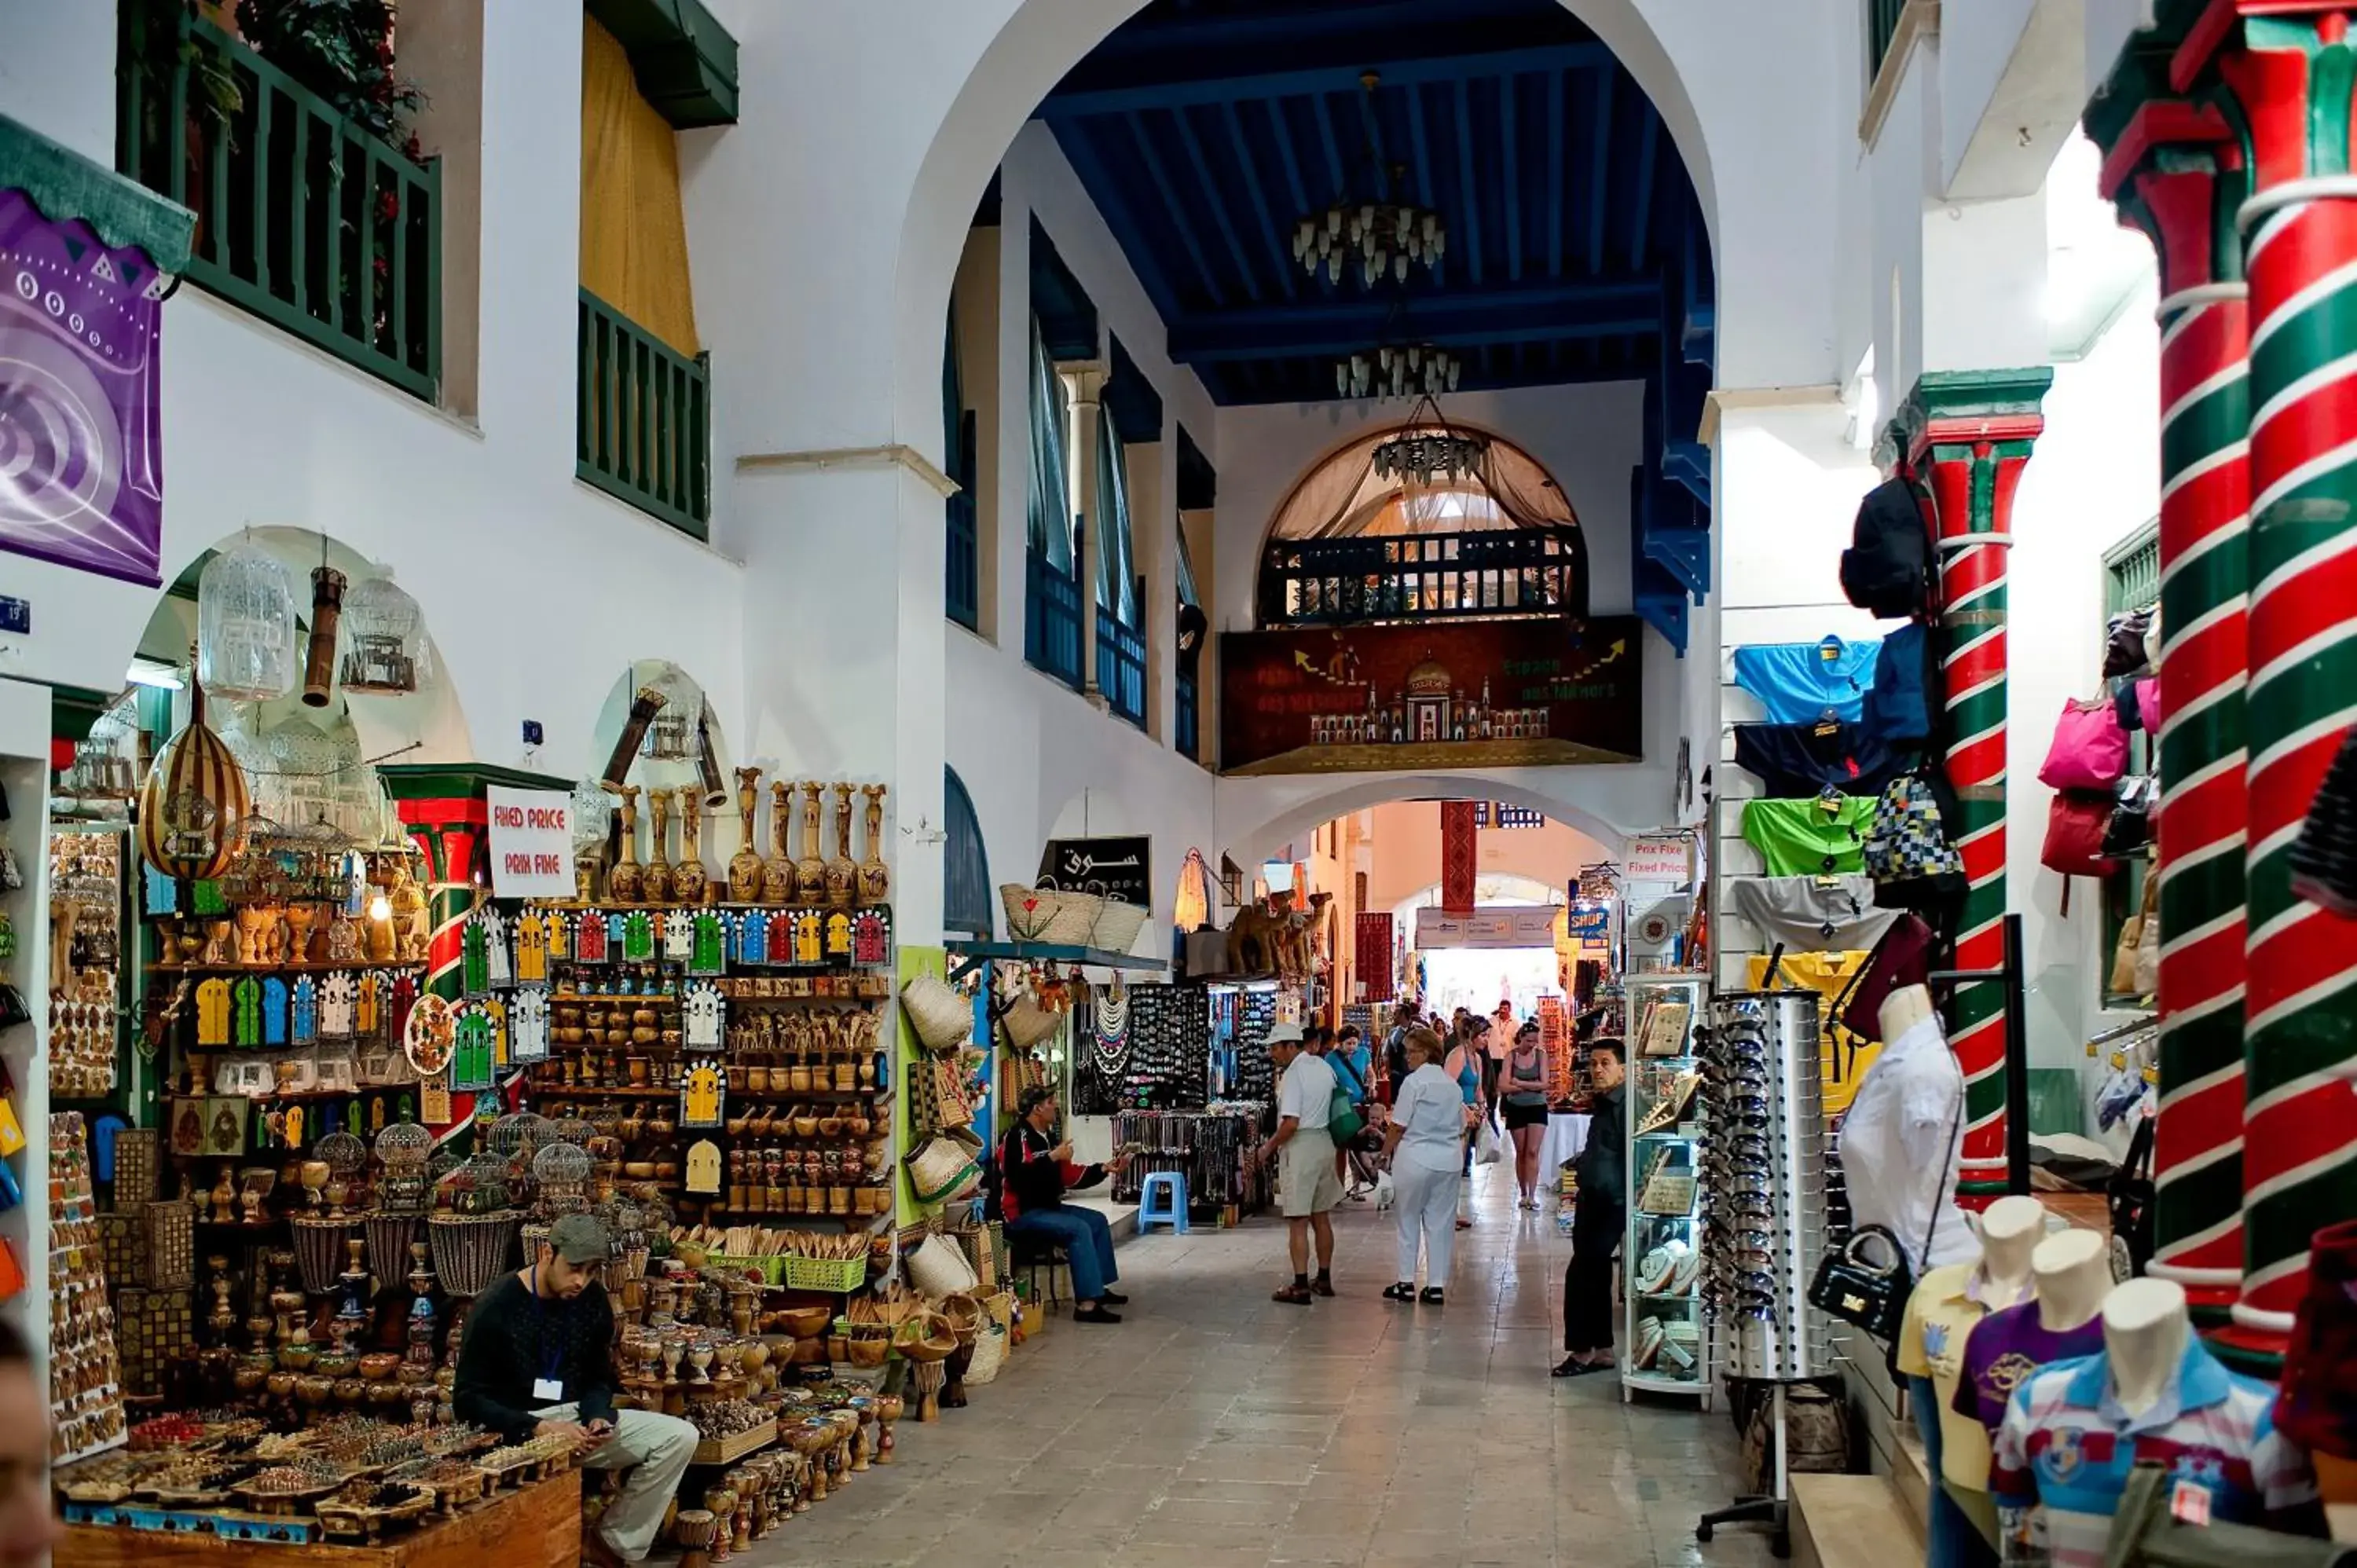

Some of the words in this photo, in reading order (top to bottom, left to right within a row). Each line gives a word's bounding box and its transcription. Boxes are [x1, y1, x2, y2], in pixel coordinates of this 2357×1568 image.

[494, 805, 523, 827] FIXED
[527, 808, 565, 830] PRICE
[505, 852, 531, 874] PRIX
[1064, 848, 1139, 876] سوق
[1629, 862, 1657, 873] Fixed
[1571, 912, 1605, 928] SHOP
